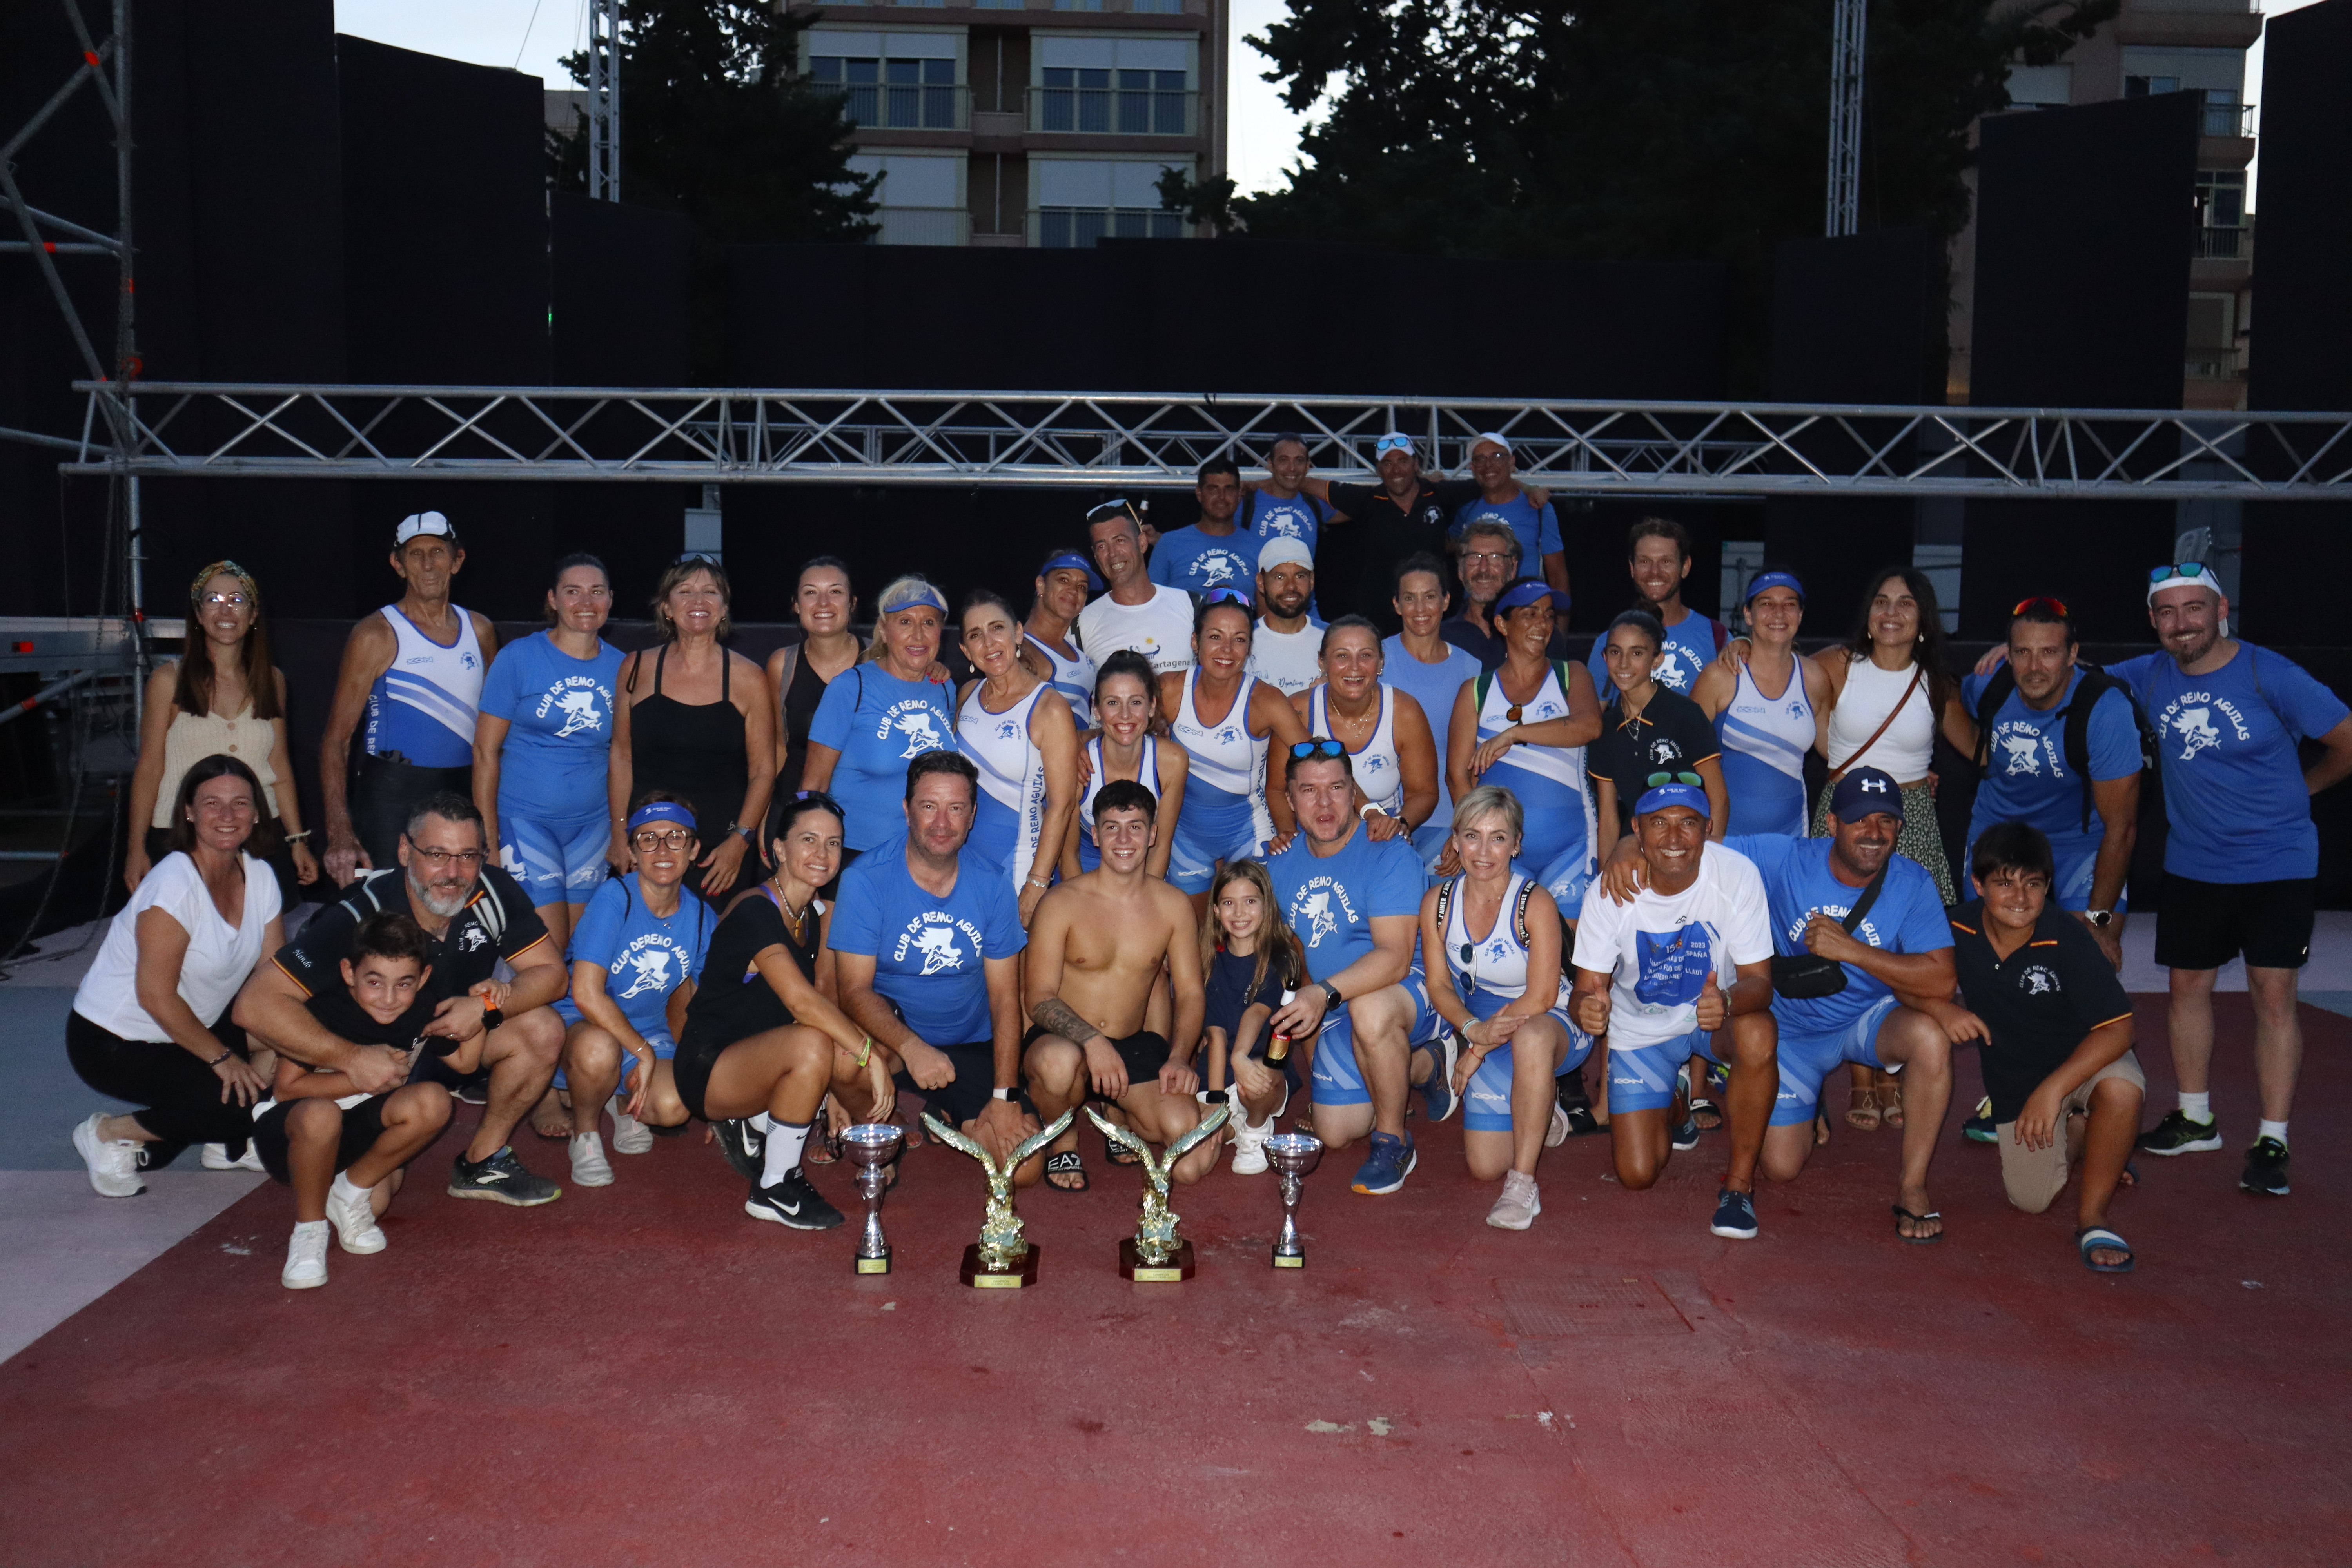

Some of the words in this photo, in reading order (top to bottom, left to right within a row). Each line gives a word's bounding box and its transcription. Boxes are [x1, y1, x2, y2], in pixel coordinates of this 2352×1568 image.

[1189, 561, 1199, 576] CLUB
[1197, 553, 1207, 562] DE
[1207, 548, 1228, 557] REMO
[1662, 641, 1677, 650] MO
[1678, 646, 1703, 672] AGUIL
[368, 695, 379, 717] CLUB
[535, 693, 554, 719] CLUB
[549, 680, 566, 695] DE
[564, 676, 595, 688] REMO
[596, 685, 613, 714] AGUIL
[368, 720, 379, 734] DE
[877, 717, 892, 740] CLUB
[886, 705, 900, 718] DE
[898, 699, 927, 711] REMO
[1998, 722, 2010, 735] DE
[2013, 721, 2040, 737] REMO
[2165, 699, 2180, 715] DE
[2180, 691, 2210, 706] REMO
[2213, 698, 2250, 741] AGUILAS
[1029, 807, 1039, 834] REMO
[1442, 880, 1453, 896] J'AIME
[1289, 902, 1298, 929] CLUB
[1296, 885, 1308, 901] DE
[1308, 876, 1332, 890] REMO
[1332, 881, 1359, 924] AGUILAS
[894, 933, 911, 962] CLUB
[907, 916, 922, 934] DE
[922, 911, 954, 924] REMO
[1789, 918, 1806, 942] CLUB
[1823, 905, 1852, 918] REM
[629, 936, 645, 952] DE
[644, 933, 672, 948] REMO
[1448, 942, 1461, 952] KO
[293, 949, 312, 968] Nando
[1048, 1153, 1081, 1170] EA7
